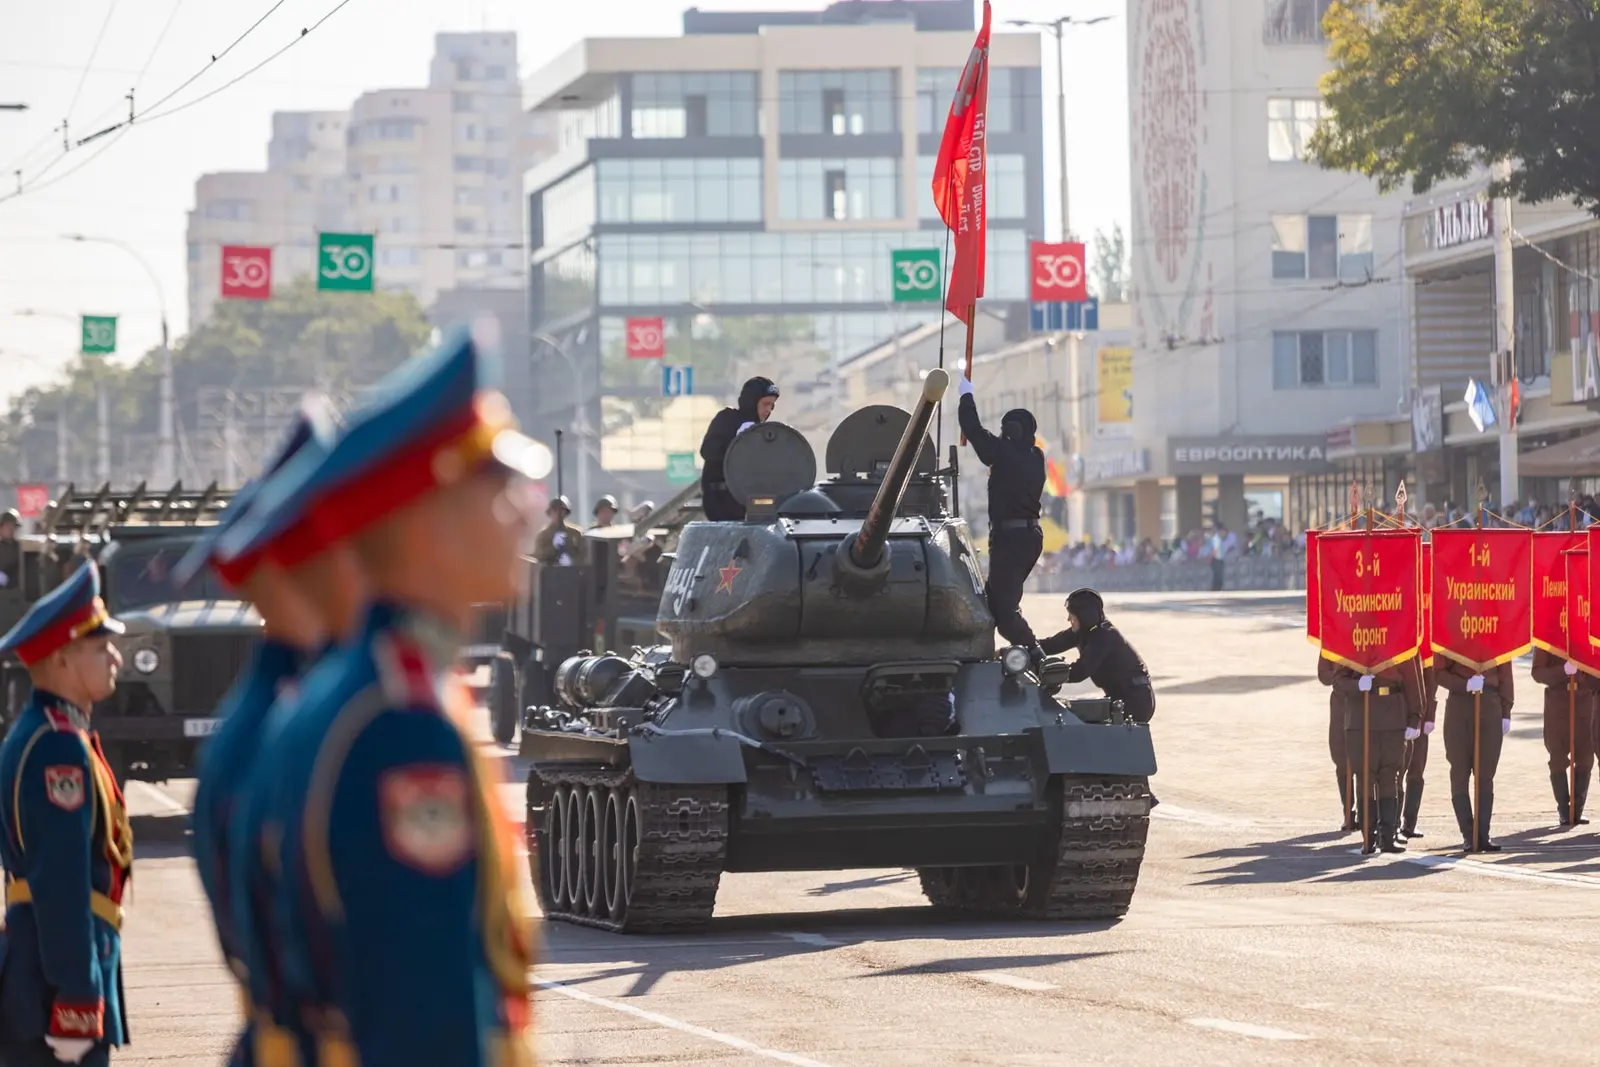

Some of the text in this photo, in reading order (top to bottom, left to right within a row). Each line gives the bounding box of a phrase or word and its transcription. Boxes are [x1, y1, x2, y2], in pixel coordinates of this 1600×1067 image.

[225, 256, 269, 288] 30
[321, 245, 371, 280] 30
[896, 260, 938, 290] 30
[1036, 255, 1082, 288] 30
[84, 321, 115, 346] 30
[629, 326, 661, 350] 30
[1175, 445, 1323, 462] ЕВРООПТИКА
[1469, 543, 1490, 567] 1-й
[1335, 586, 1402, 617] Украинский
[1446, 576, 1515, 602] Украинский
[1352, 624, 1387, 651] фронт
[1460, 611, 1499, 639] фронт
